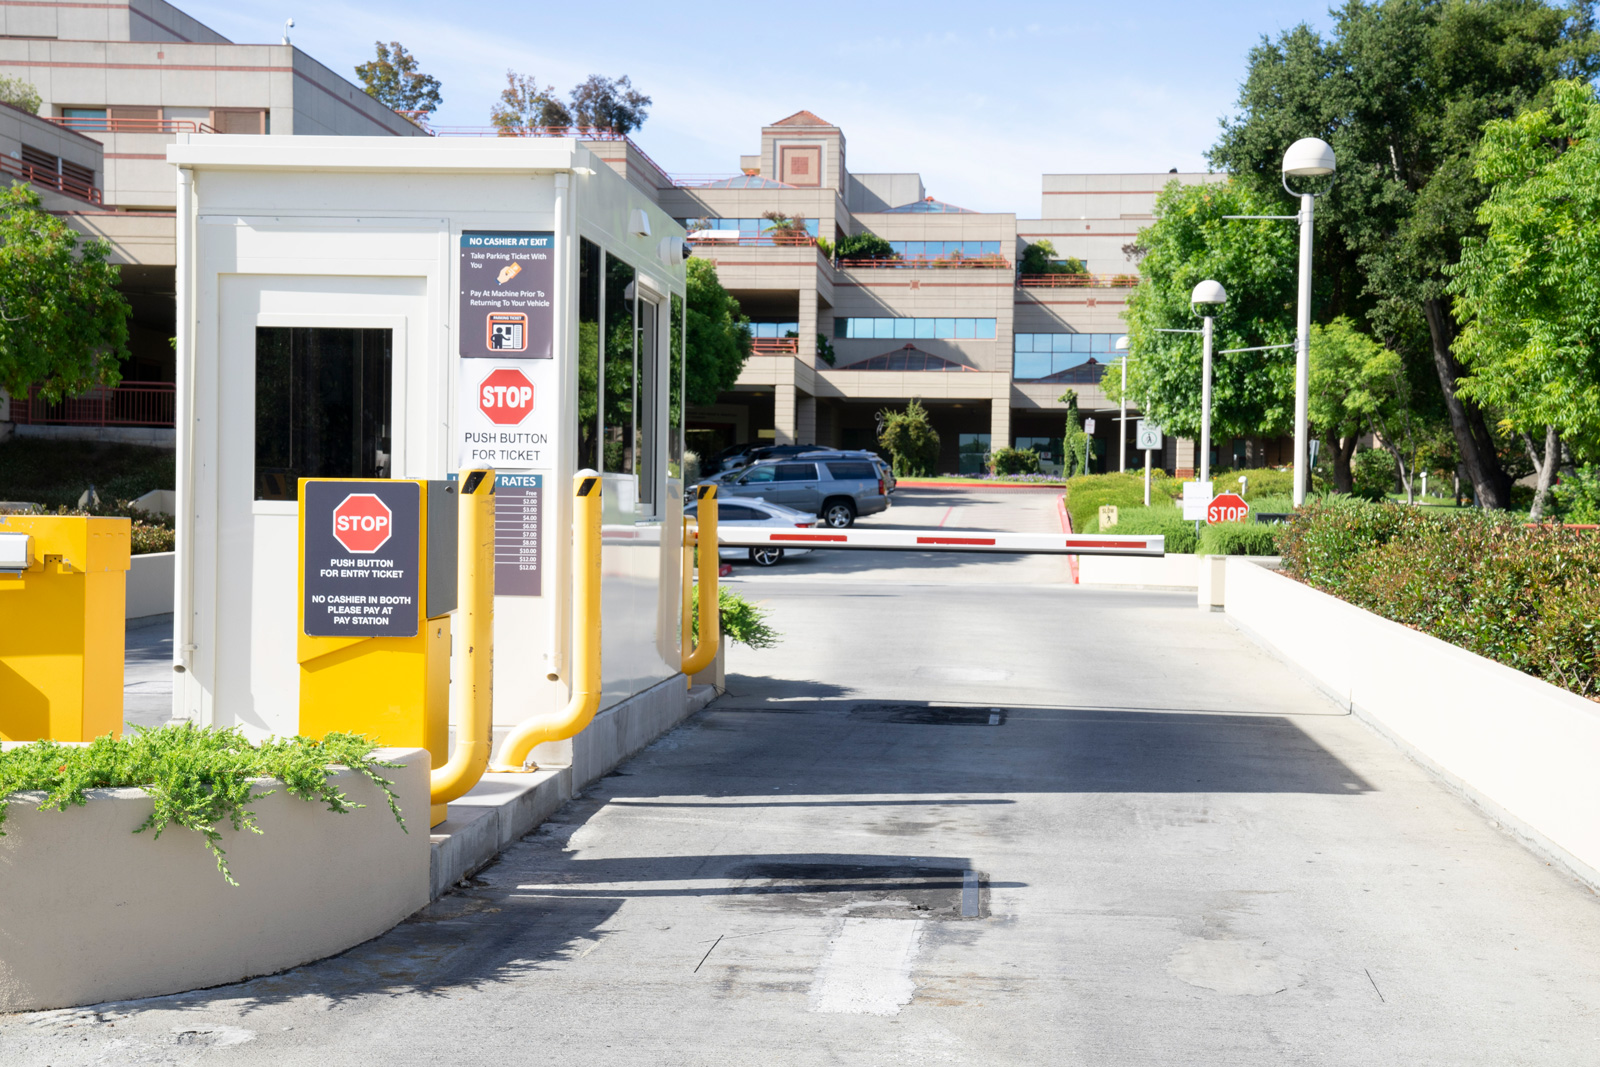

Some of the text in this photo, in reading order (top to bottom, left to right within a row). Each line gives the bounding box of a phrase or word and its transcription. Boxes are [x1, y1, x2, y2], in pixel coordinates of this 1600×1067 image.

[482, 386, 532, 408] STOP
[465, 432, 547, 443] PUSH BUTTON
[472, 450, 540, 460] FOR TICKET
[502, 477, 536, 486] RATES
[1209, 507, 1246, 522] STOP
[337, 516, 387, 531] STOP
[357, 559, 393, 567] BUTTON
[341, 570, 370, 578] ENTRY
[372, 570, 403, 578] TICKET
[328, 595, 366, 604] CASHIER
[380, 596, 411, 604] BOOTH
